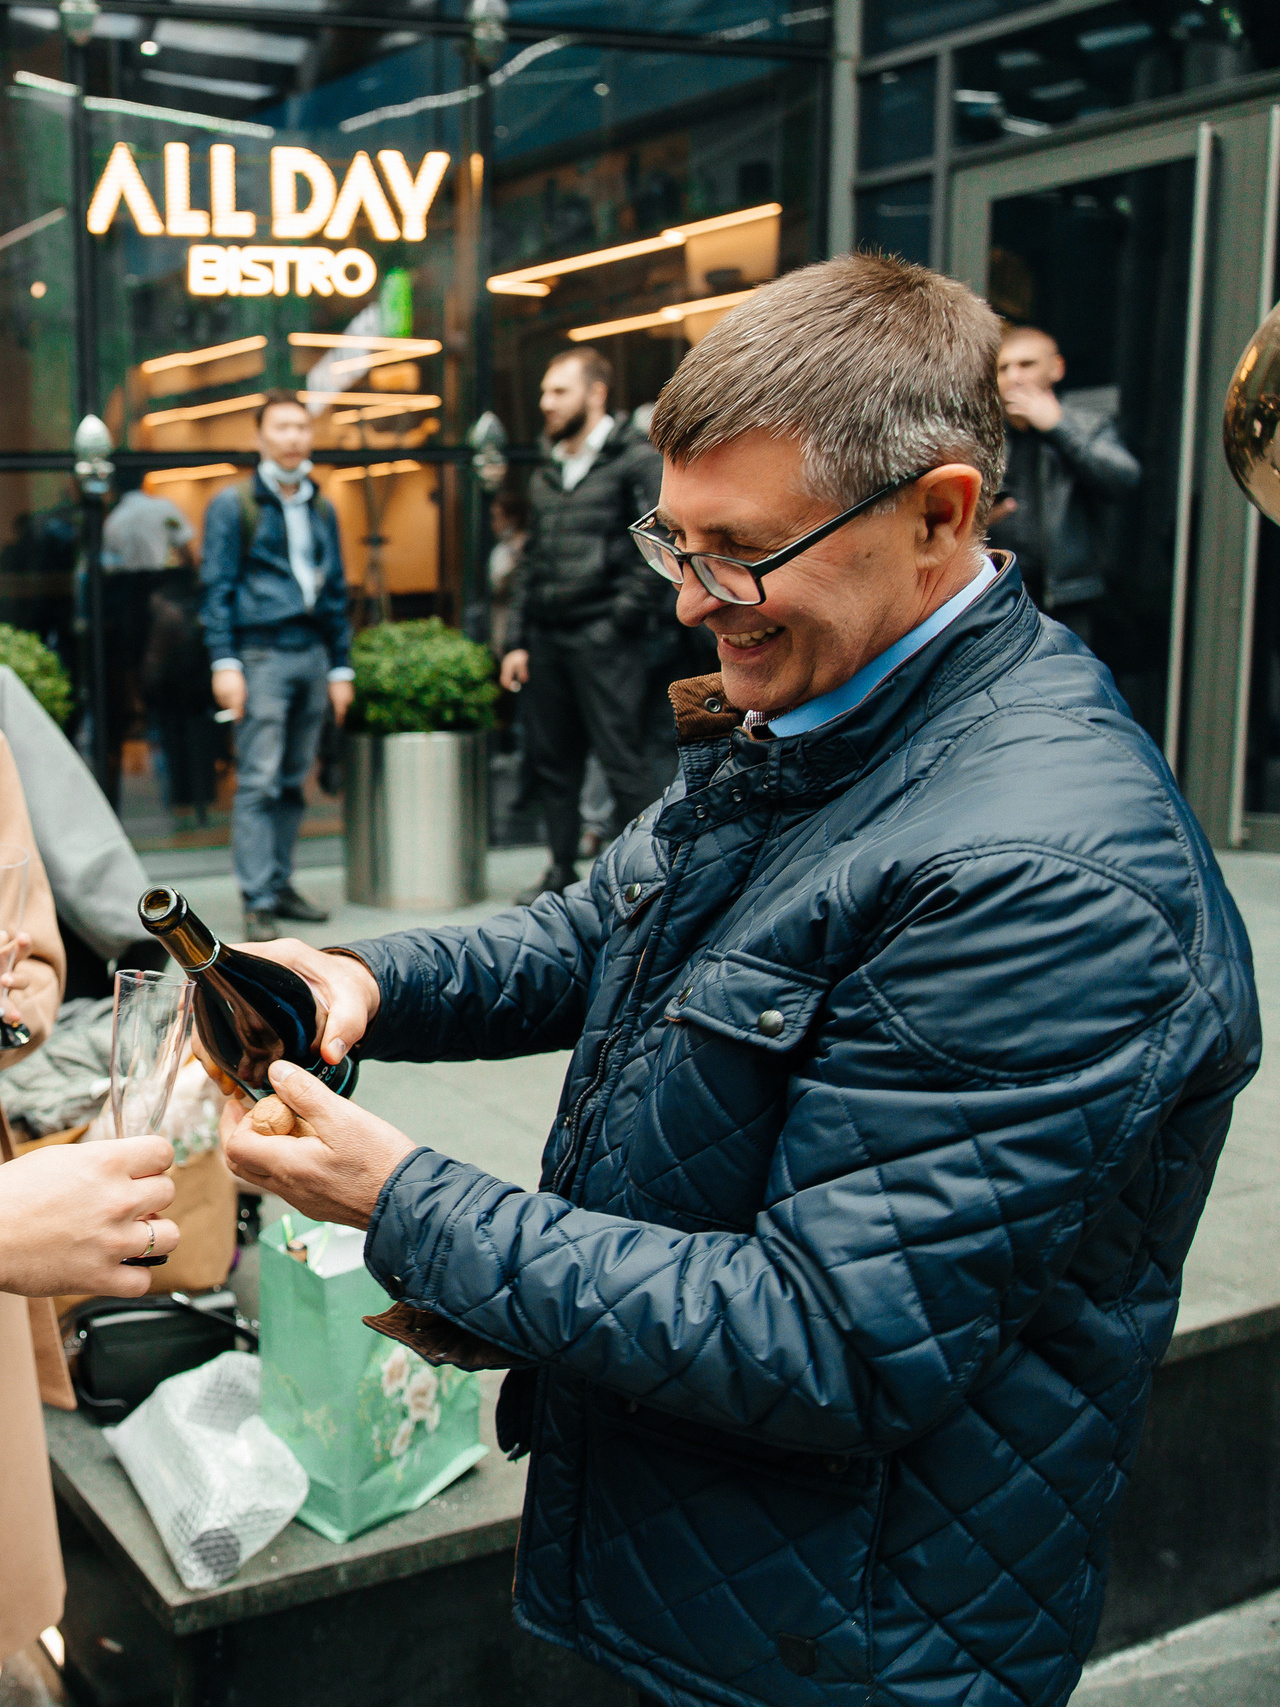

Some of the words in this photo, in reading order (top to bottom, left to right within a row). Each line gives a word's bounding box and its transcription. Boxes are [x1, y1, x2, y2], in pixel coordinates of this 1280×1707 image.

[87, 141, 257, 237] ALL
[270, 145, 451, 241] DAY
[188, 244, 378, 298] BISTRO
